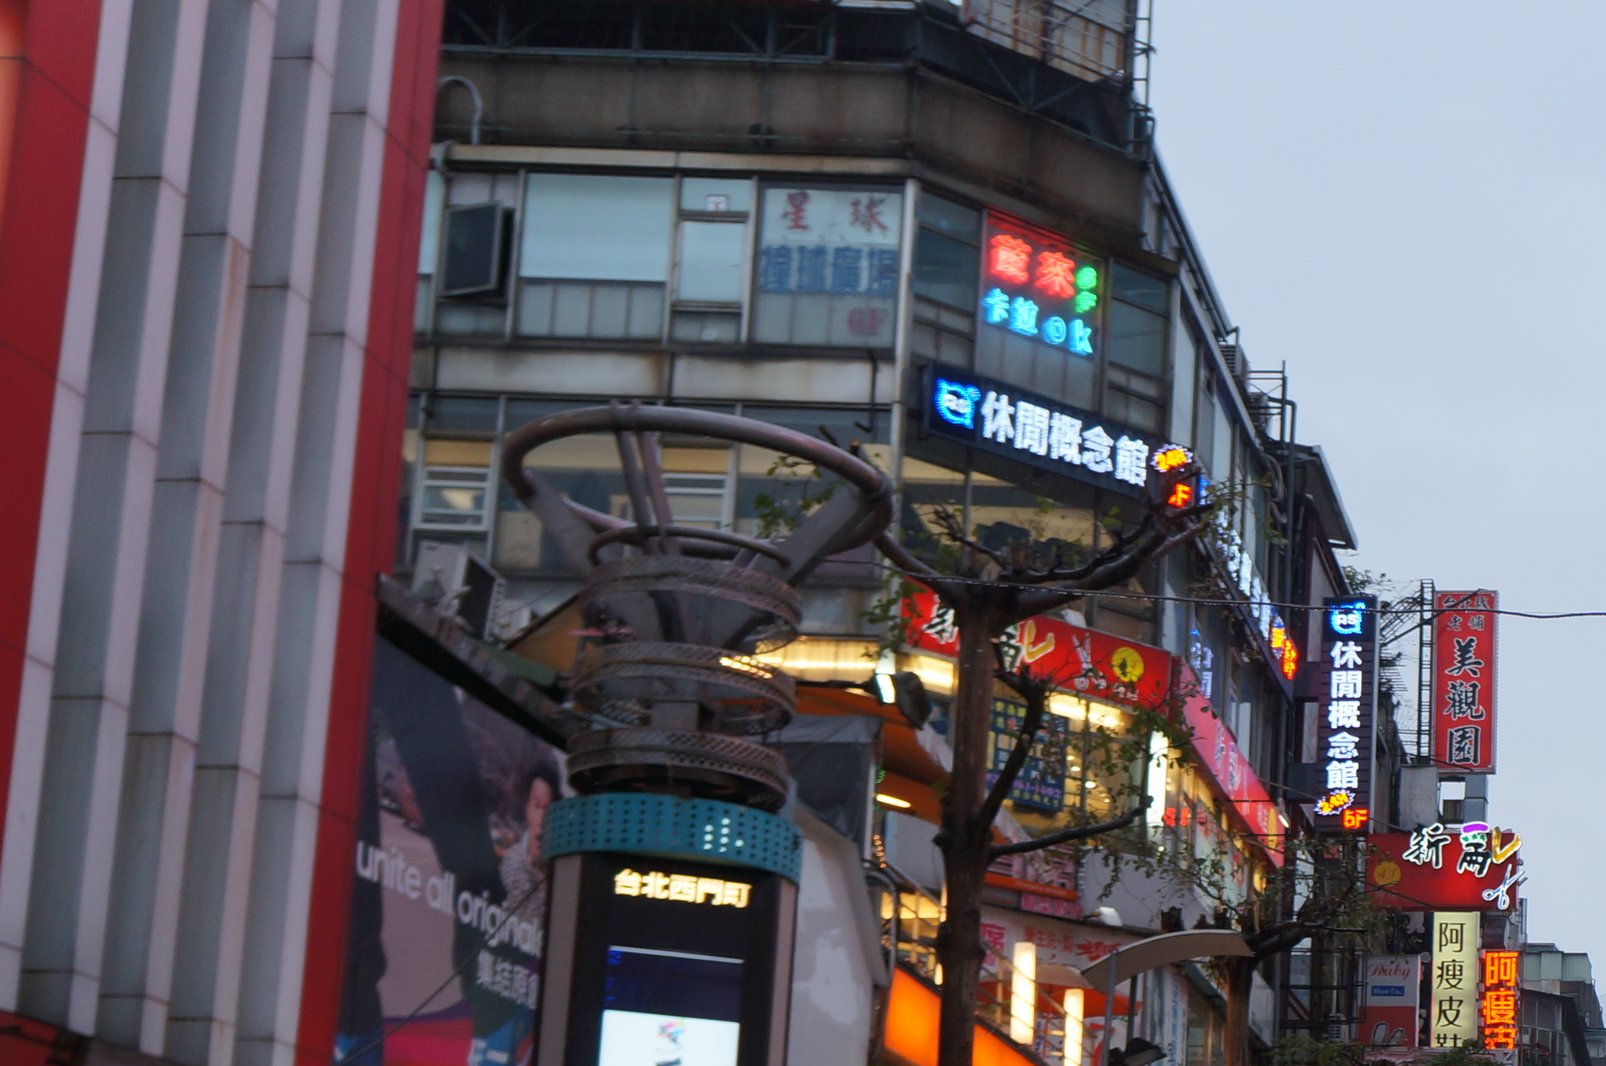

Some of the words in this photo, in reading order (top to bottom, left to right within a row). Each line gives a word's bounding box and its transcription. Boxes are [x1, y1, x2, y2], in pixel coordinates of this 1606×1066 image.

[1326, 640, 1363, 790] 休閒概念館
[1443, 636, 1487, 766] 美觀園
[1343, 808, 1368, 829] 5F
[356, 842, 421, 900] unite
[426, 872, 455, 915] all
[613, 867, 752, 910] 台北西門町
